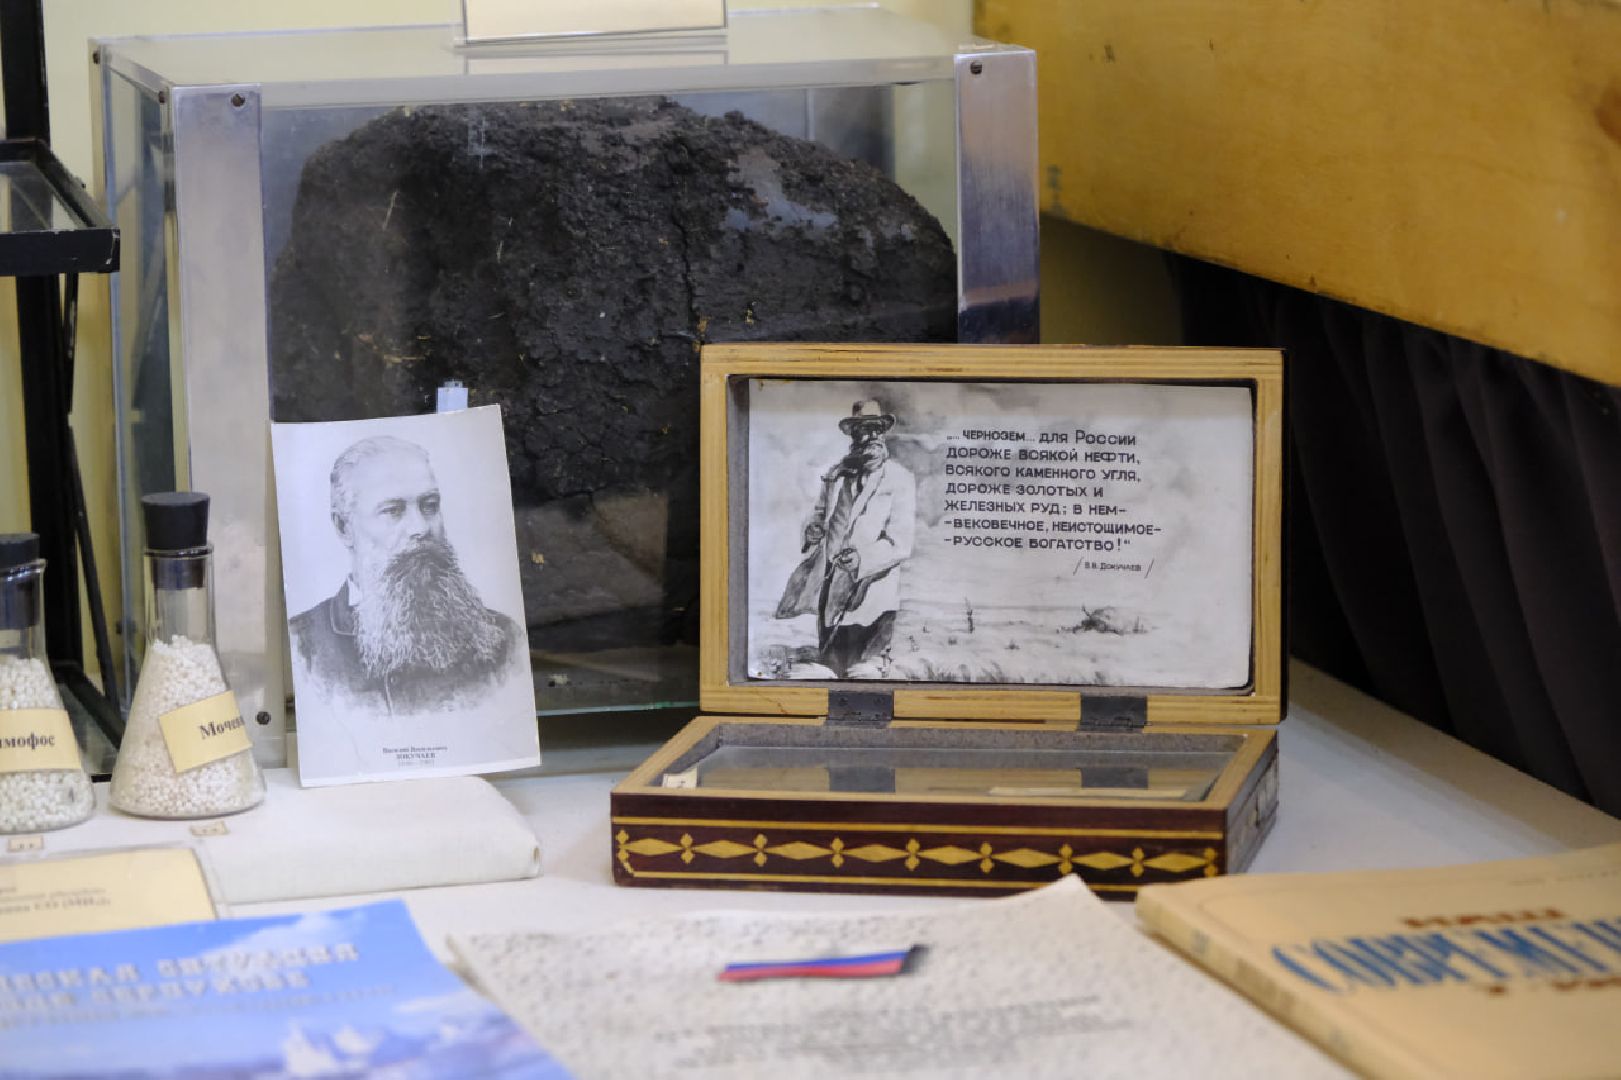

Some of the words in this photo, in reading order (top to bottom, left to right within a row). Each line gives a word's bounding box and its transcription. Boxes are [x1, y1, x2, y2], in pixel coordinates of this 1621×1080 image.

[946, 447, 1012, 460] ДОРОЖЕ
[1018, 448, 1078, 462] ВСЯКОЙ
[1084, 452, 1141, 464] НЕФТИ,
[945, 464, 1010, 477] ВСЯКОГО
[1015, 467, 1096, 480] КАМЕННОГО
[1101, 469, 1141, 483] УГЛЯ,
[945, 482, 1011, 495] ДОРОЖЕ
[1015, 484, 1087, 497] ЗОЛОТЫХ
[1093, 487, 1104, 497] И
[944, 500, 1025, 513] ЖЕЛЕЗНЫХ
[1073, 504, 1083, 515] В
